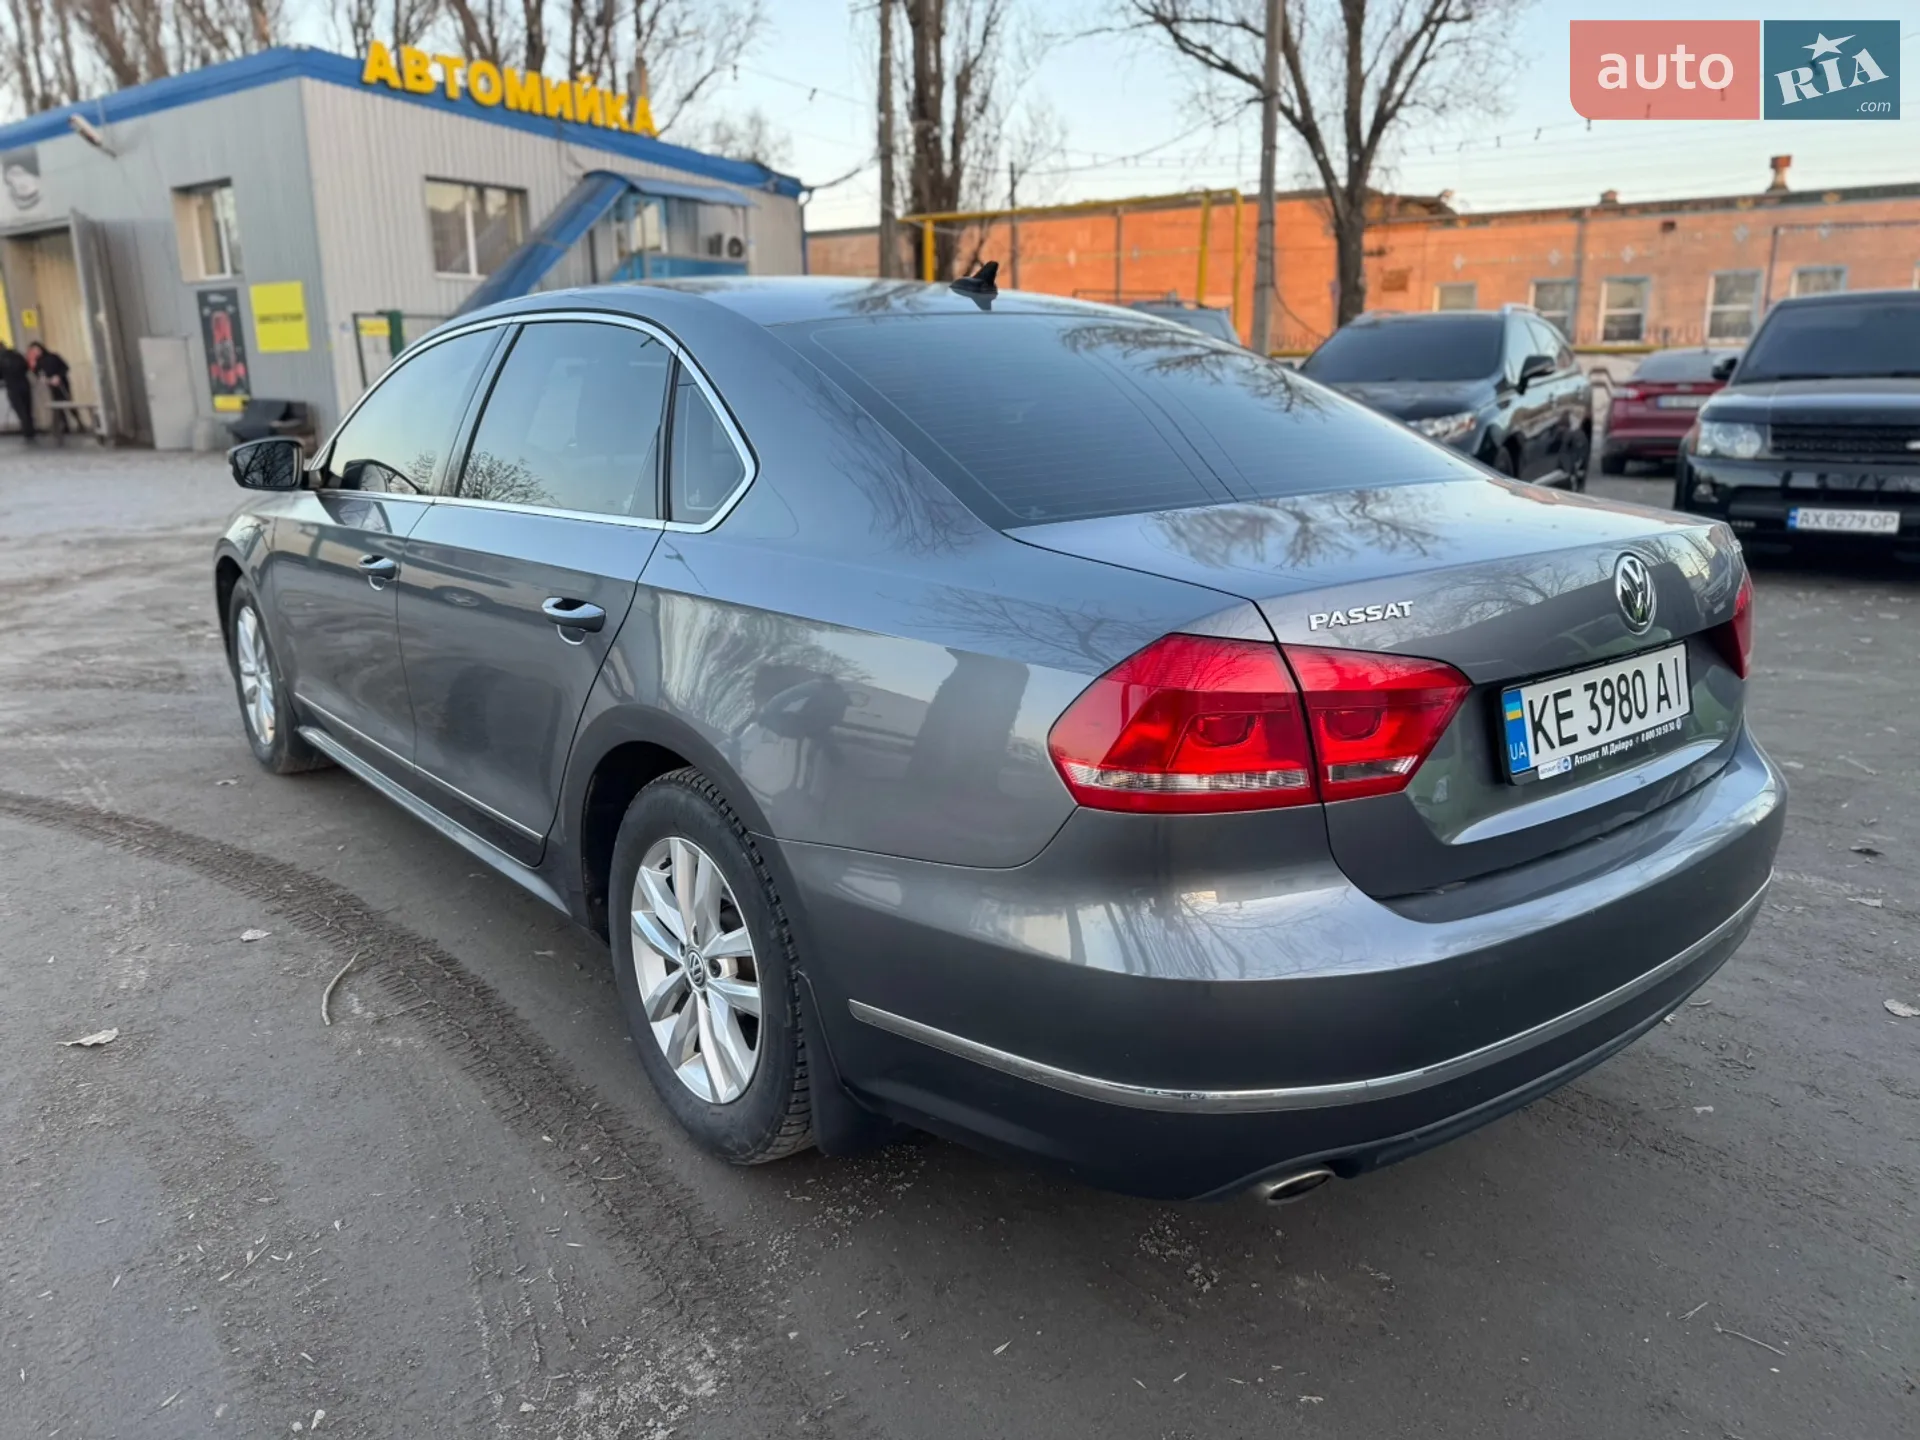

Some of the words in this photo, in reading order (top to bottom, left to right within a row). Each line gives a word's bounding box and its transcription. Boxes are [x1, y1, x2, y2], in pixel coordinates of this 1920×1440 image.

[362, 40, 661, 138] АВТОМИЙКА
[1799, 511, 1823, 526] AX
[1826, 513, 1868, 527] 8279
[1870, 514, 1896, 529] OP
[1308, 600, 1414, 631] PASSAT
[1528, 689, 1579, 755] KE
[1584, 669, 1648, 736] 3980
[1657, 657, 1682, 714] AI
[1510, 743, 1528, 761] UA
[1574, 750, 1600, 767] Атлант
